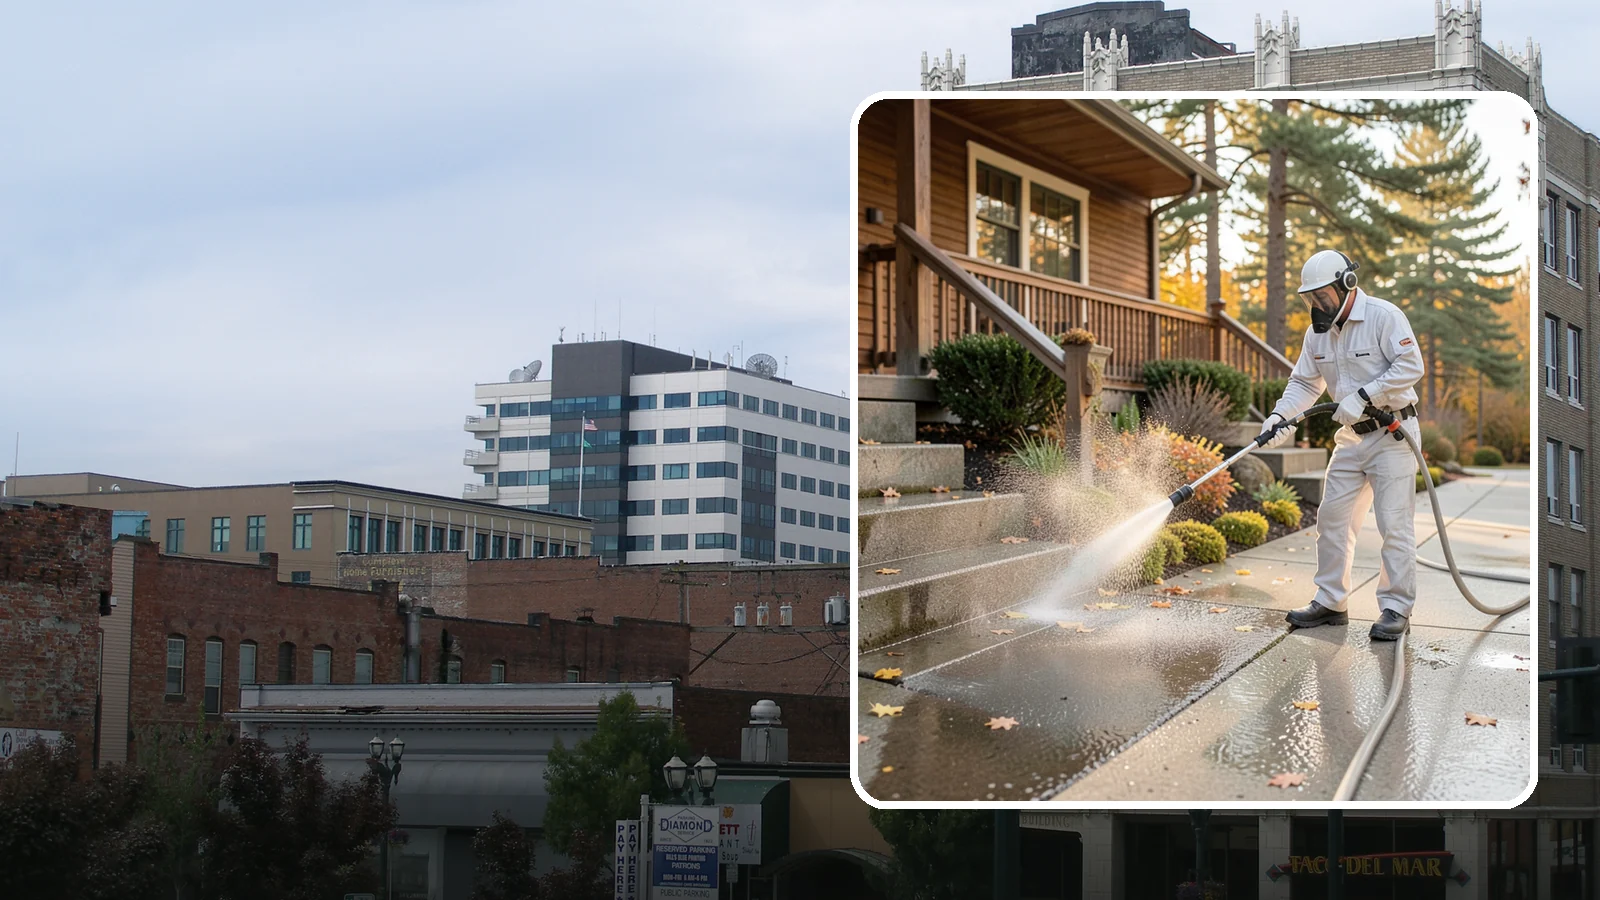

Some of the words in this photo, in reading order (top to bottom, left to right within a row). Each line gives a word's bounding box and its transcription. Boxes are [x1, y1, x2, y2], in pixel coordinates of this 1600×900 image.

[344, 568, 368, 576] Home
[370, 566, 427, 576] Furnishers
[660, 818, 712, 832] DIAMOND
[1022, 815, 1069, 828] BUILDING
[617, 825, 625, 852] PAY
[628, 824, 636, 852] PAY
[690, 846, 716, 854] PARKING
[722, 851, 738, 862] Soup
[672, 862, 700, 870] PATRONS
[1346, 856, 1384, 876] DEL
[1392, 857, 1442, 876] MAR
[617, 856, 625, 893] HERE
[628, 856, 636, 893] HERE
[660, 888, 682, 896] PUBLIC
[684, 889, 710, 898] PARKING
